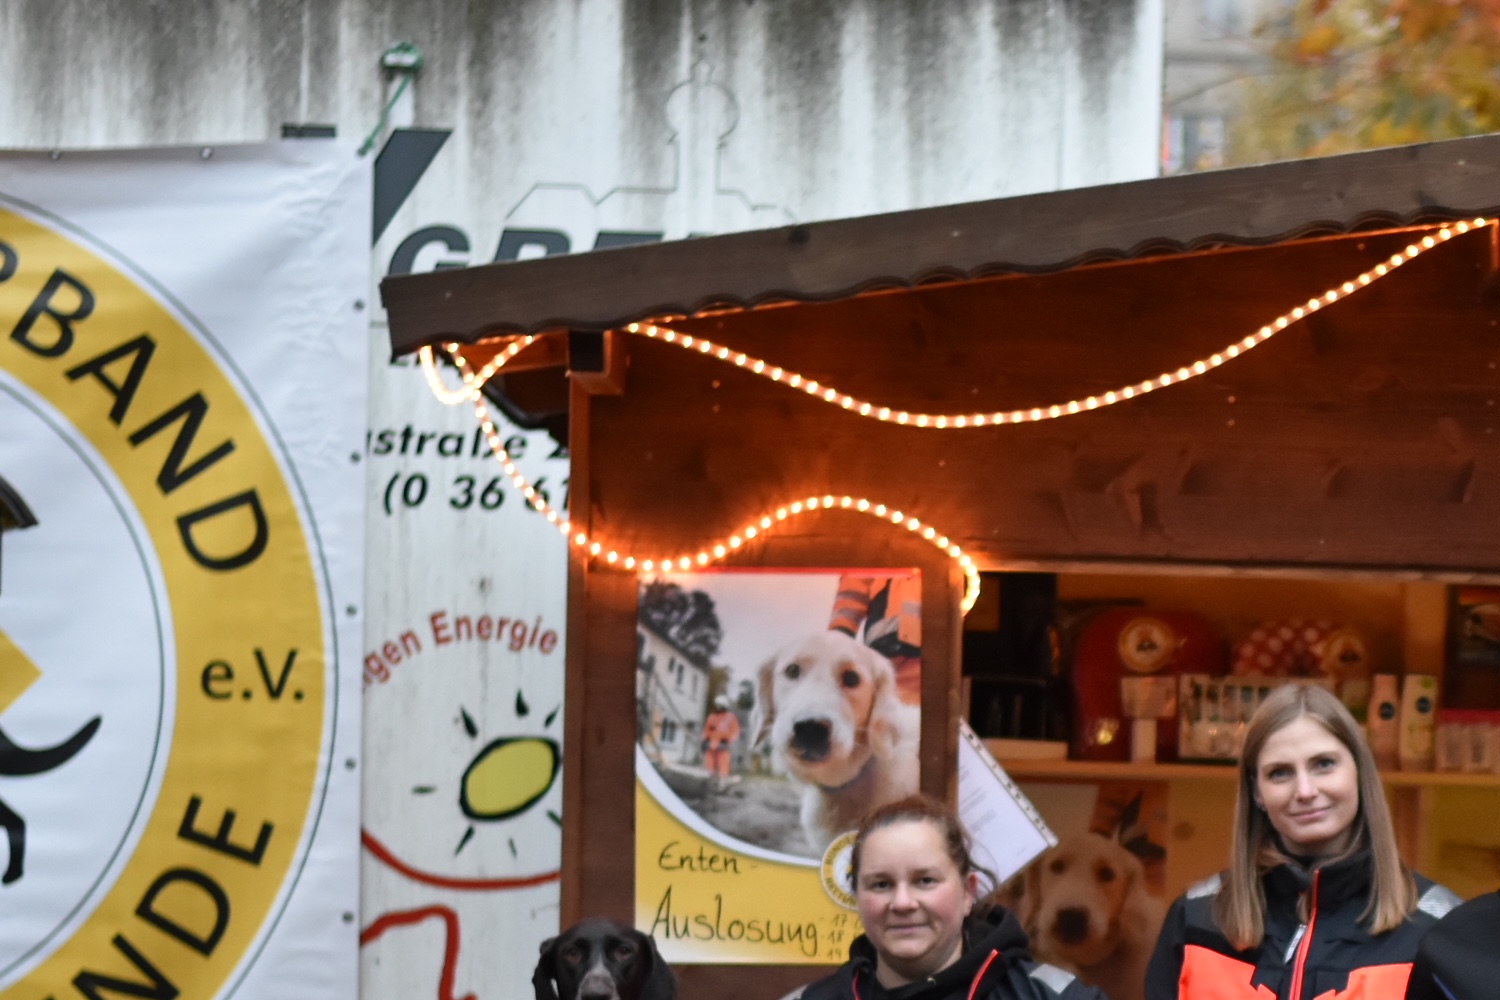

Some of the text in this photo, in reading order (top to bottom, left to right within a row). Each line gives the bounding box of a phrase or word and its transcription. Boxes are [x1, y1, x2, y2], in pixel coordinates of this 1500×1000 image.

[384, 472, 428, 516] (0
[450, 475, 505, 510] 36
[364, 611, 558, 683] gen Energie
[202, 648, 304, 701] e.V.
[658, 841, 741, 875] Enten
[650, 883, 818, 957] Auslosung
